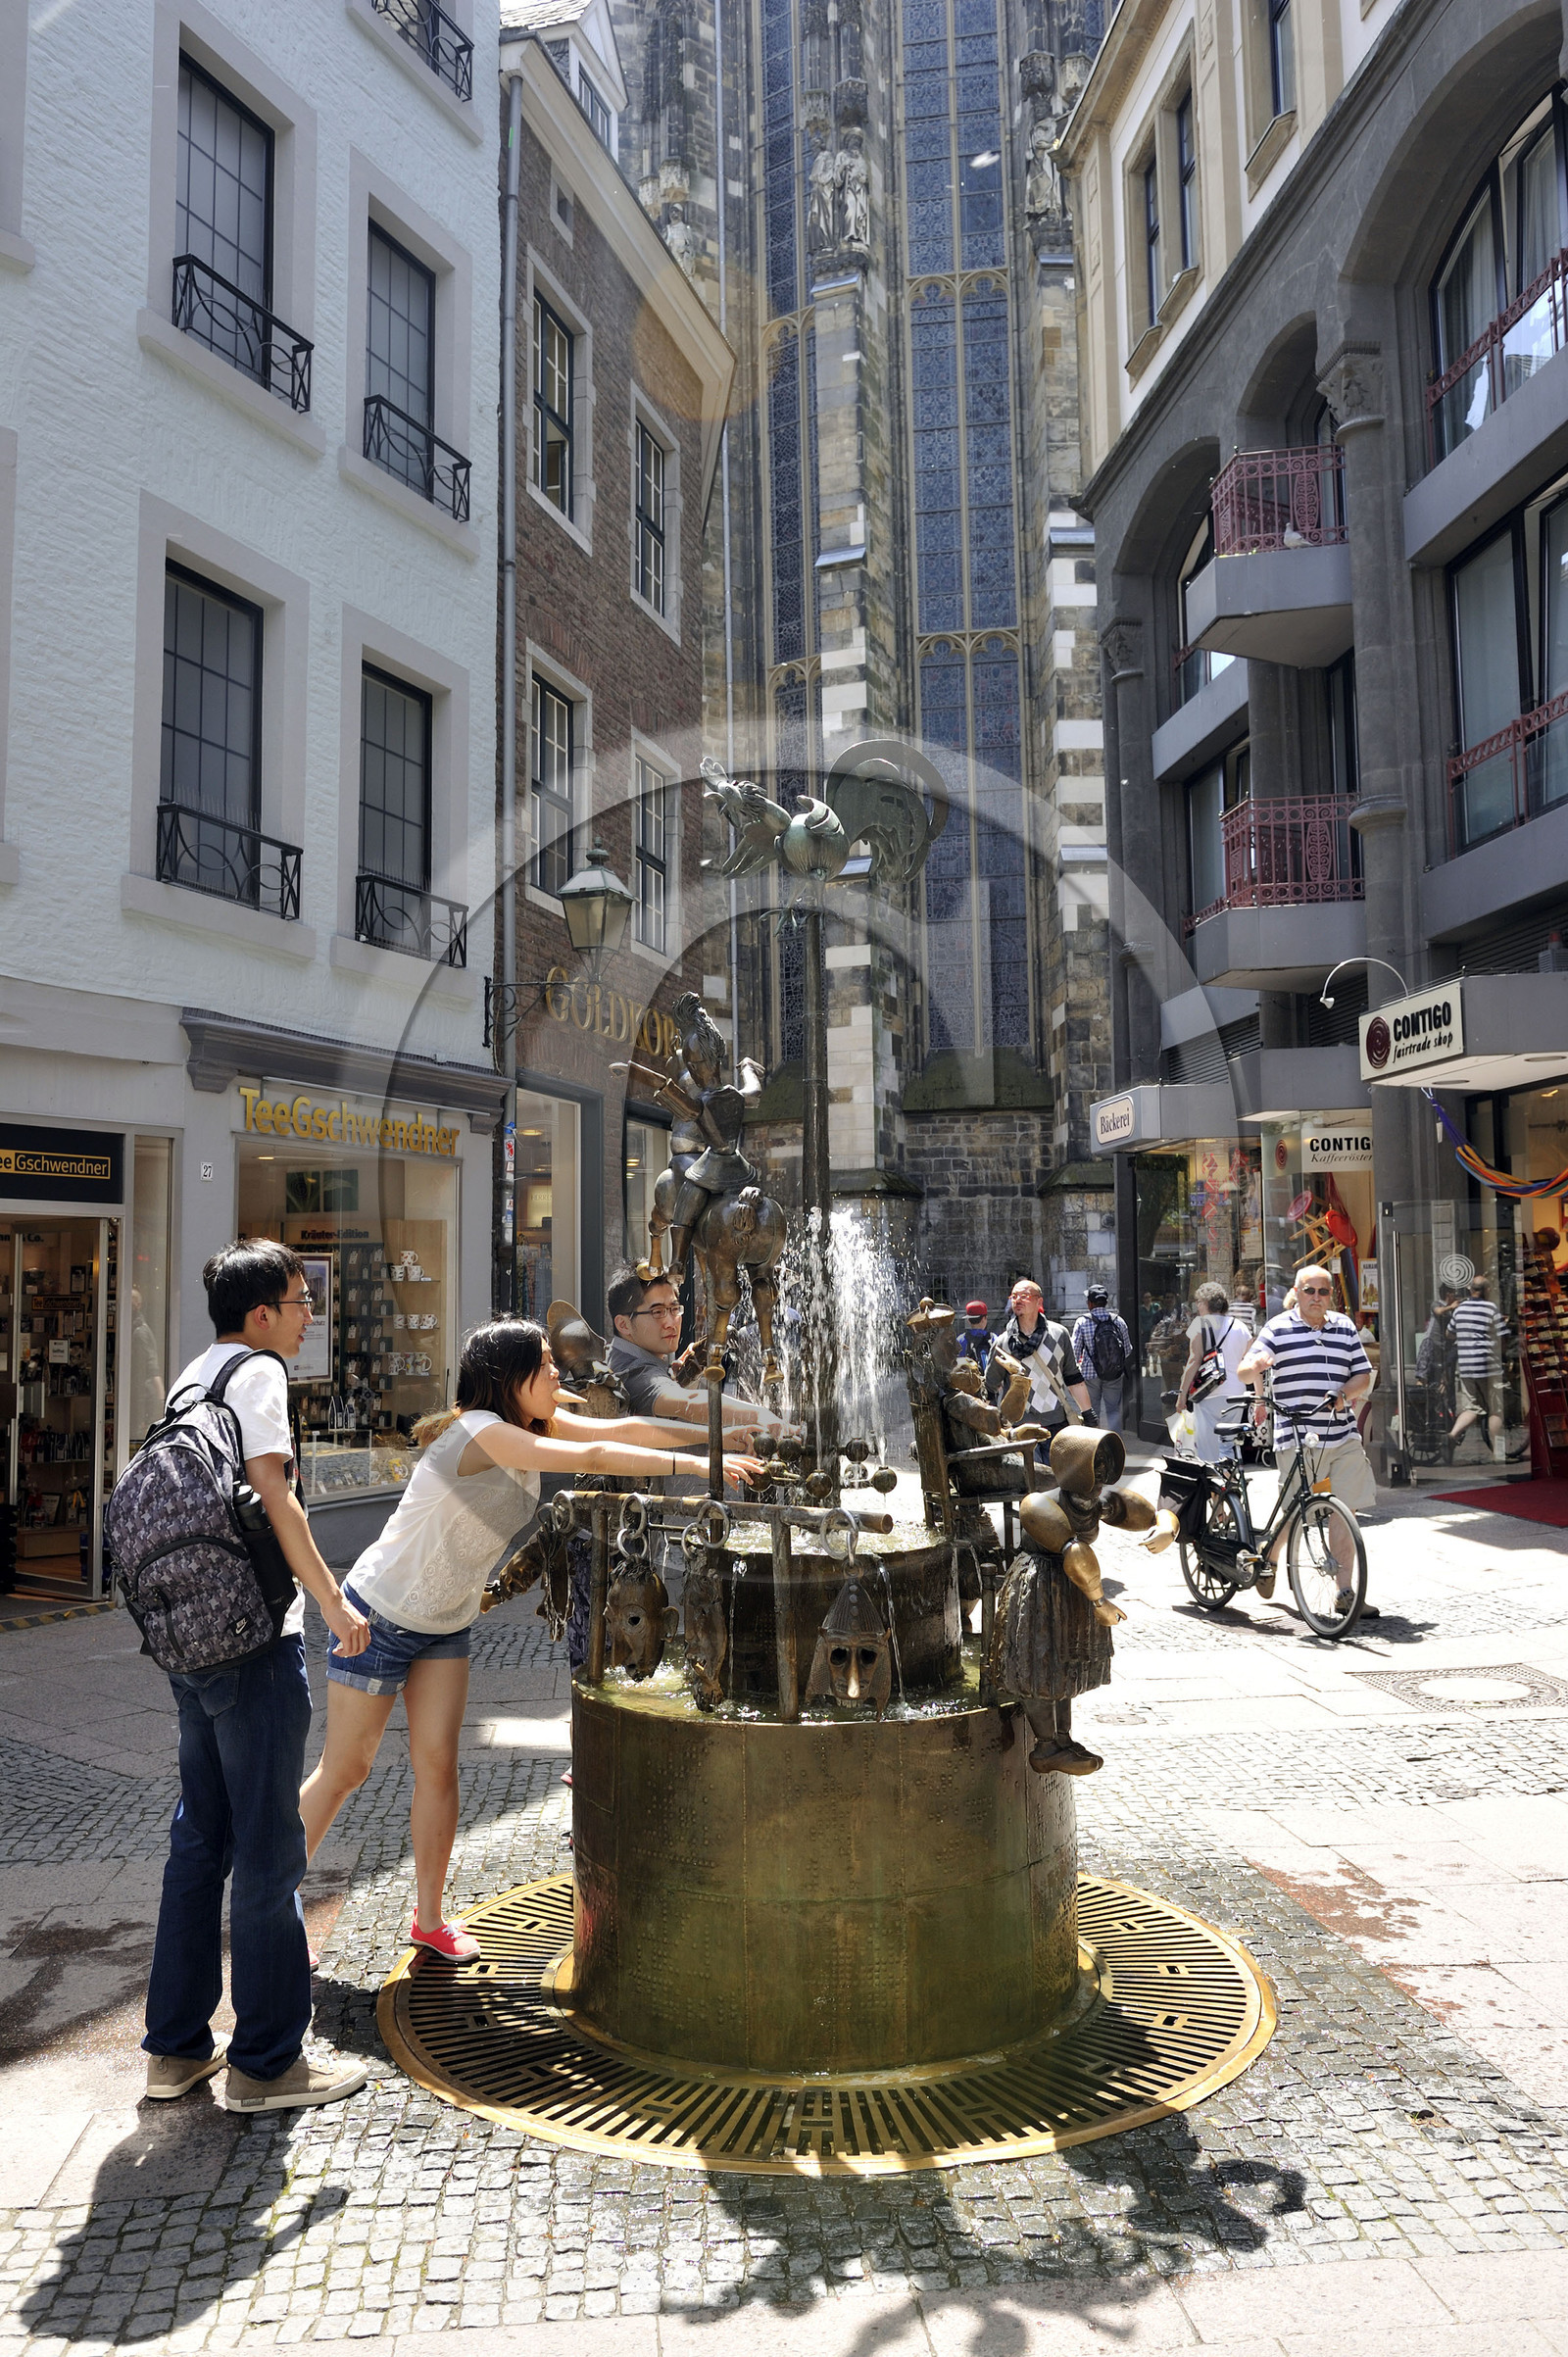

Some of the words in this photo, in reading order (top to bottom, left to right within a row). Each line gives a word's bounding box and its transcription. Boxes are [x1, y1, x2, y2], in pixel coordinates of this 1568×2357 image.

[1393, 1001, 1452, 1043] CONTIGO
[1392, 1036, 1432, 1064] fairtrade
[1433, 1031, 1453, 1049] shop
[239, 1086, 461, 1157] TeeGschwendner
[1100, 1107, 1130, 1135] Bäckerei
[1309, 1137, 1374, 1153] CONTIG
[16, 1154, 108, 1176] Gschwendner
[203, 1164, 212, 1178] 27
[300, 1228, 369, 1241] Kräuter-Edition
